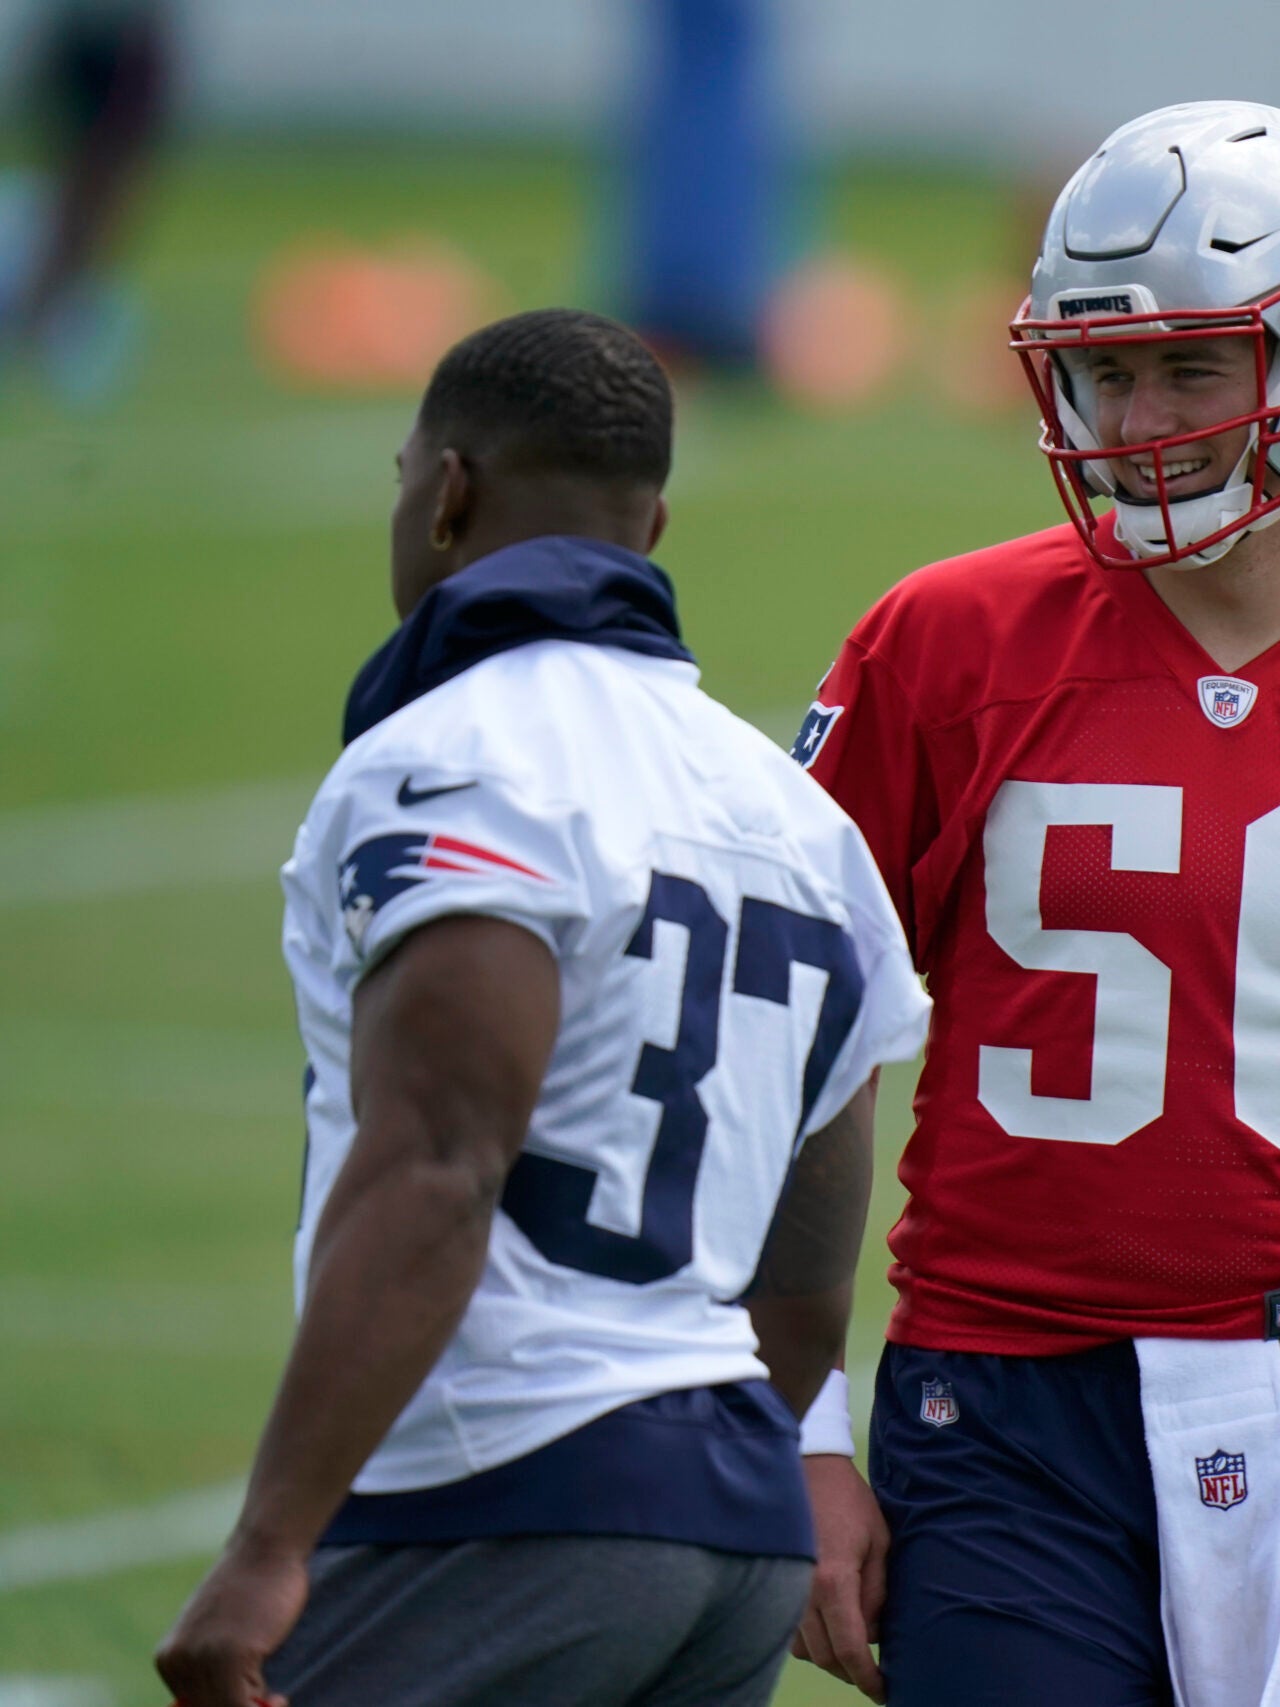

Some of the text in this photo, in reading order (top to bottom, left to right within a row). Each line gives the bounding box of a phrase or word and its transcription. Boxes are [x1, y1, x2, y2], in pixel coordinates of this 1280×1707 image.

[1058, 295, 1133, 320] PATRIOTS
[1205, 682, 1250, 694] EQUIPMENT
[1215, 702, 1236, 716] NFL
[499, 869, 866, 1303] 37
[926, 1399, 955, 1420] NFL
[1202, 1474, 1245, 1504] NFL
